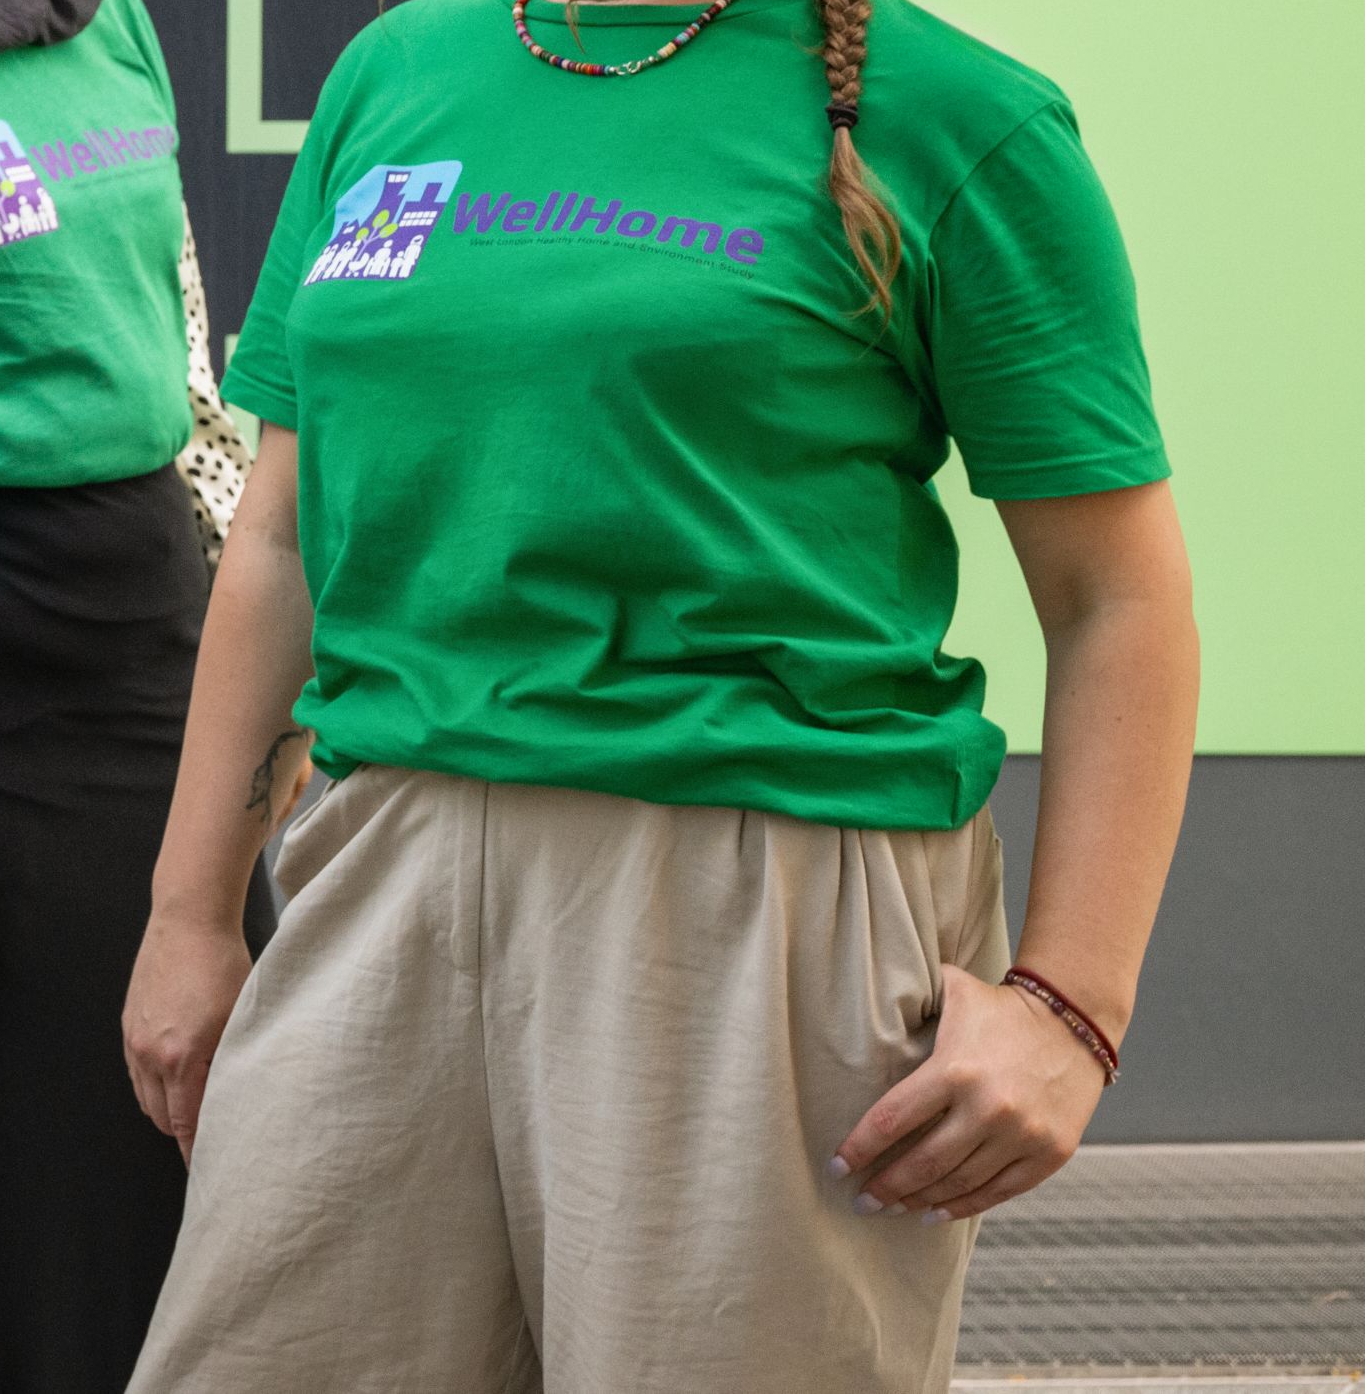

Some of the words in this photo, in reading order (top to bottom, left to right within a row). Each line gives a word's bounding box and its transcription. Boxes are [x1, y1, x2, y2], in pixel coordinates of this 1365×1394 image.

[30, 125, 175, 183] WellHom
[453, 191, 764, 265] WellHome
[614, 239, 636, 249] and
[639, 242, 715, 269] Environment
[719, 262, 755, 280] Study
